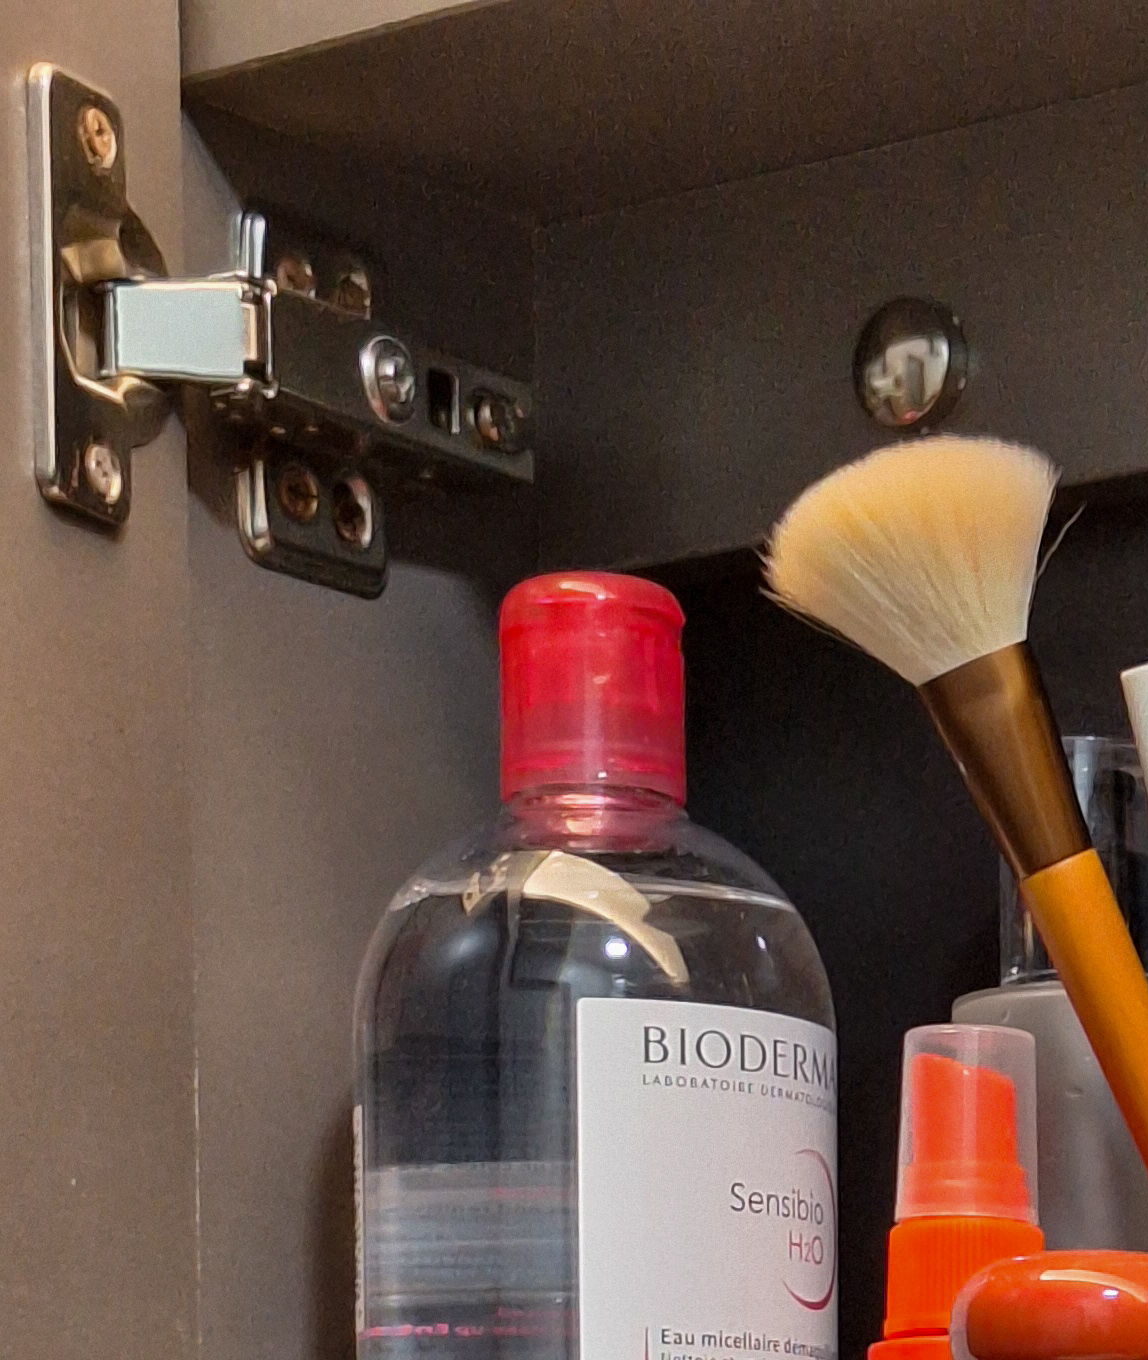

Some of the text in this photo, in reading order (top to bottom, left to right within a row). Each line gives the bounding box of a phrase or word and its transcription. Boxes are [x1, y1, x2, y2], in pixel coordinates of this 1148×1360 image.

[730, 1182, 825, 1226] Sensibio
[661, 1328, 695, 1346] Eau
[702, 1330, 781, 1353] micellaire
